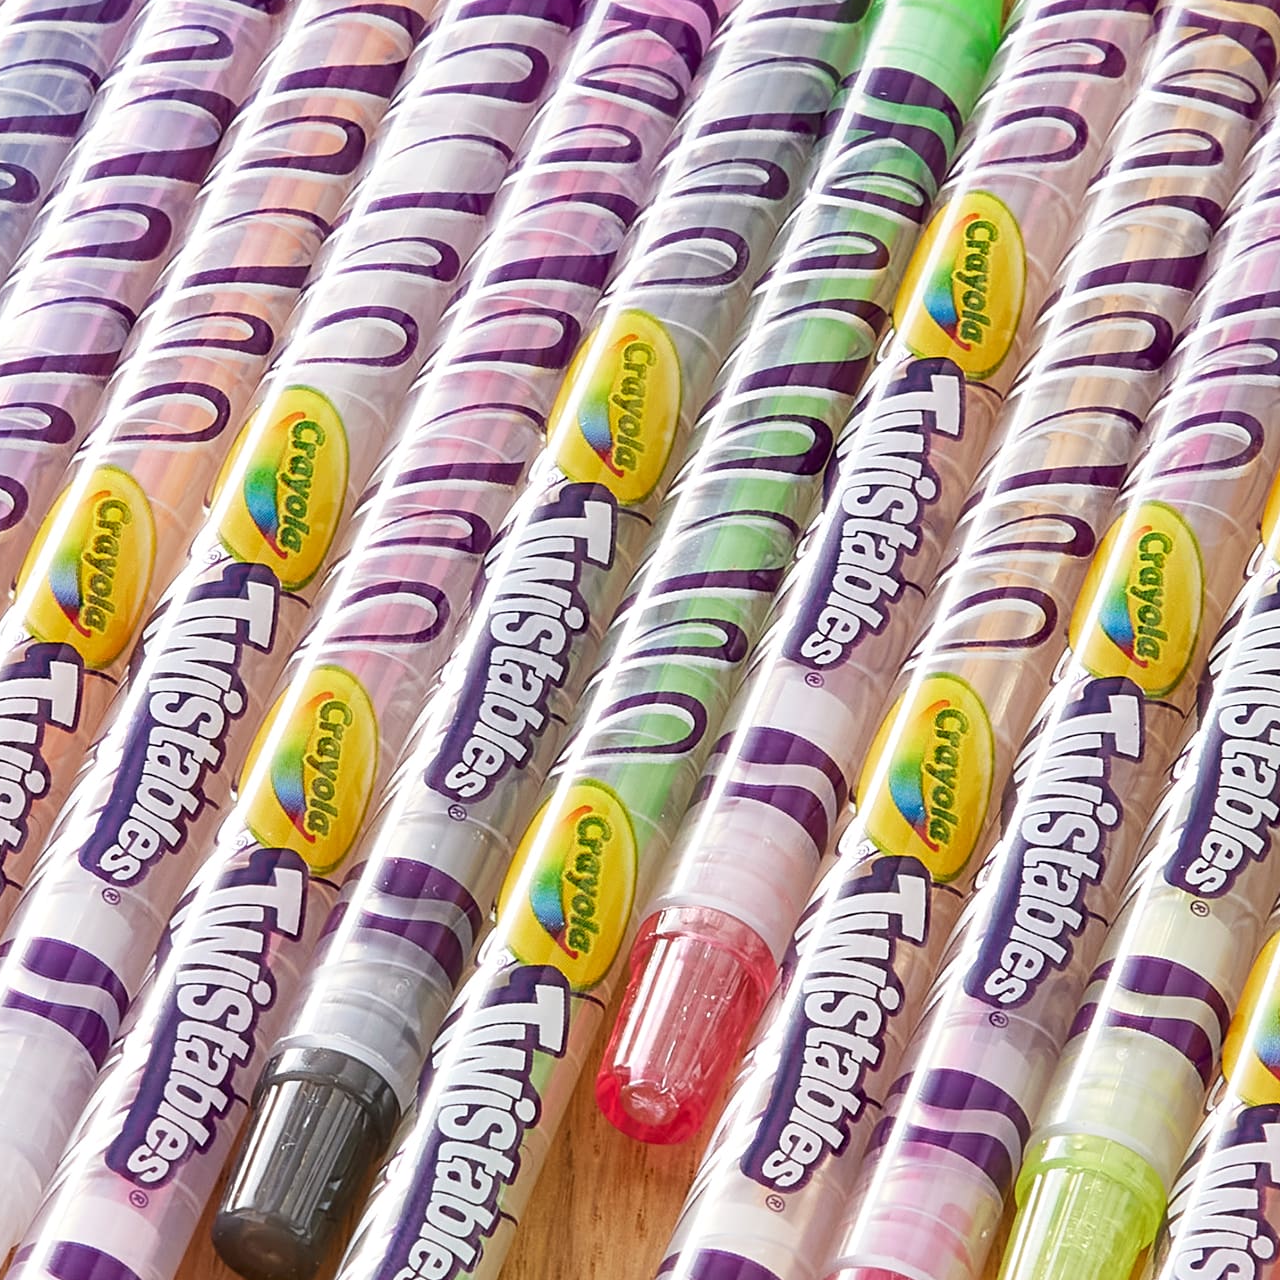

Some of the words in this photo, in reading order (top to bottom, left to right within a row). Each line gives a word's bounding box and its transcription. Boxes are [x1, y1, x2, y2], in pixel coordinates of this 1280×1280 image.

[954, 220, 998, 347] Crayola
[608, 341, 658, 474] Crayola
[276, 418, 326, 556] Crayola
[801, 374, 960, 665] Twistables
[81, 496, 130, 635] Crayola
[1126, 530, 1173, 662] Crayola
[445, 498, 614, 799] Twistables
[100, 579, 276, 882] Twistables
[304, 699, 353, 840] Crayola
[921, 707, 968, 845] Crayola
[560, 813, 612, 953] Crayola
[984, 695, 1140, 1003] Twistables
[126, 867, 303, 1184] Twistables
[762, 874, 926, 1187] Twistables
